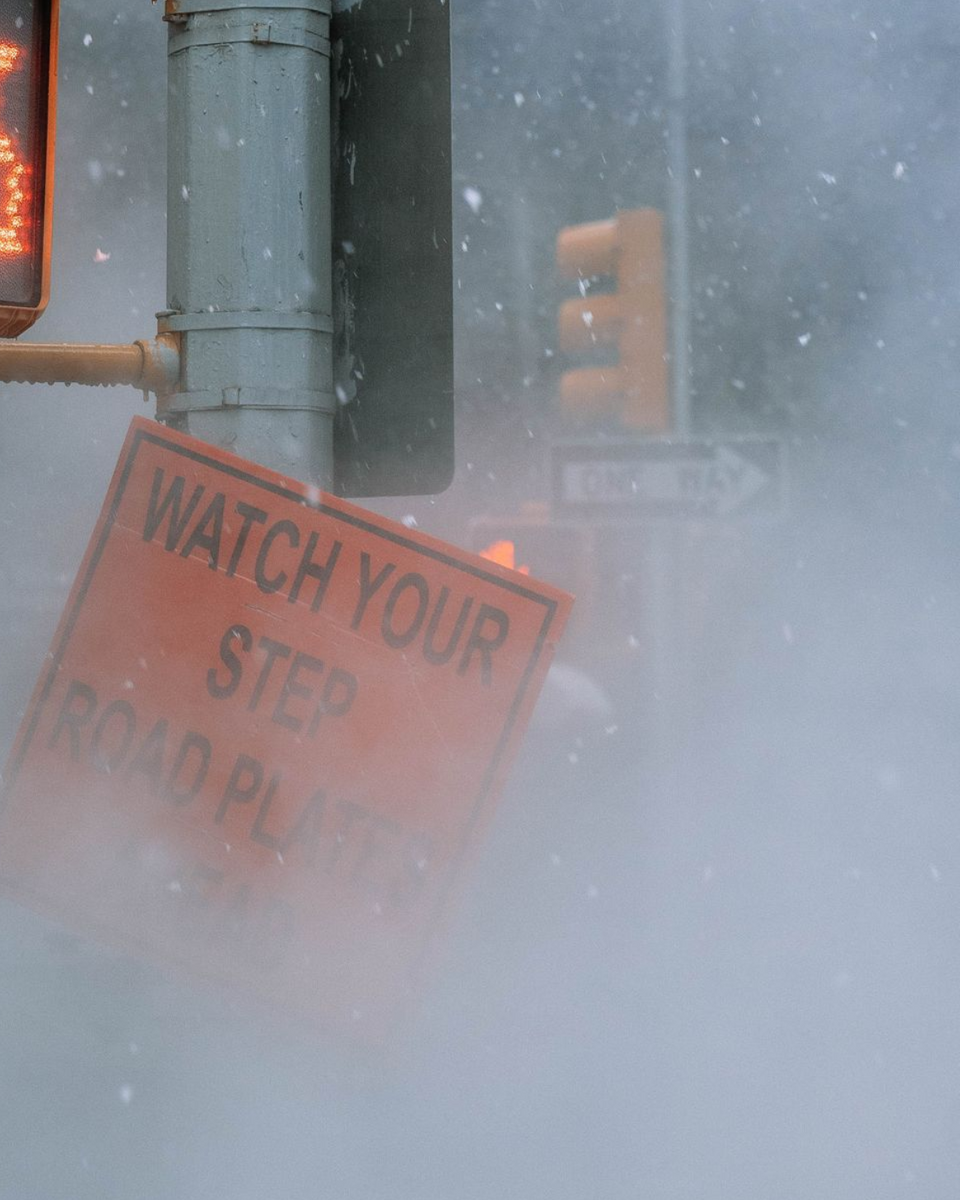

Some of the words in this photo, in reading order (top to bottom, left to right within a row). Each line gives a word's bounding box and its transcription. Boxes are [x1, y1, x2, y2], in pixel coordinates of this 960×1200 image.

[140, 467, 343, 613] WATCH
[349, 551, 510, 686] YOUR
[47, 681, 212, 804] ROAD
[207, 625, 358, 739] STEP
